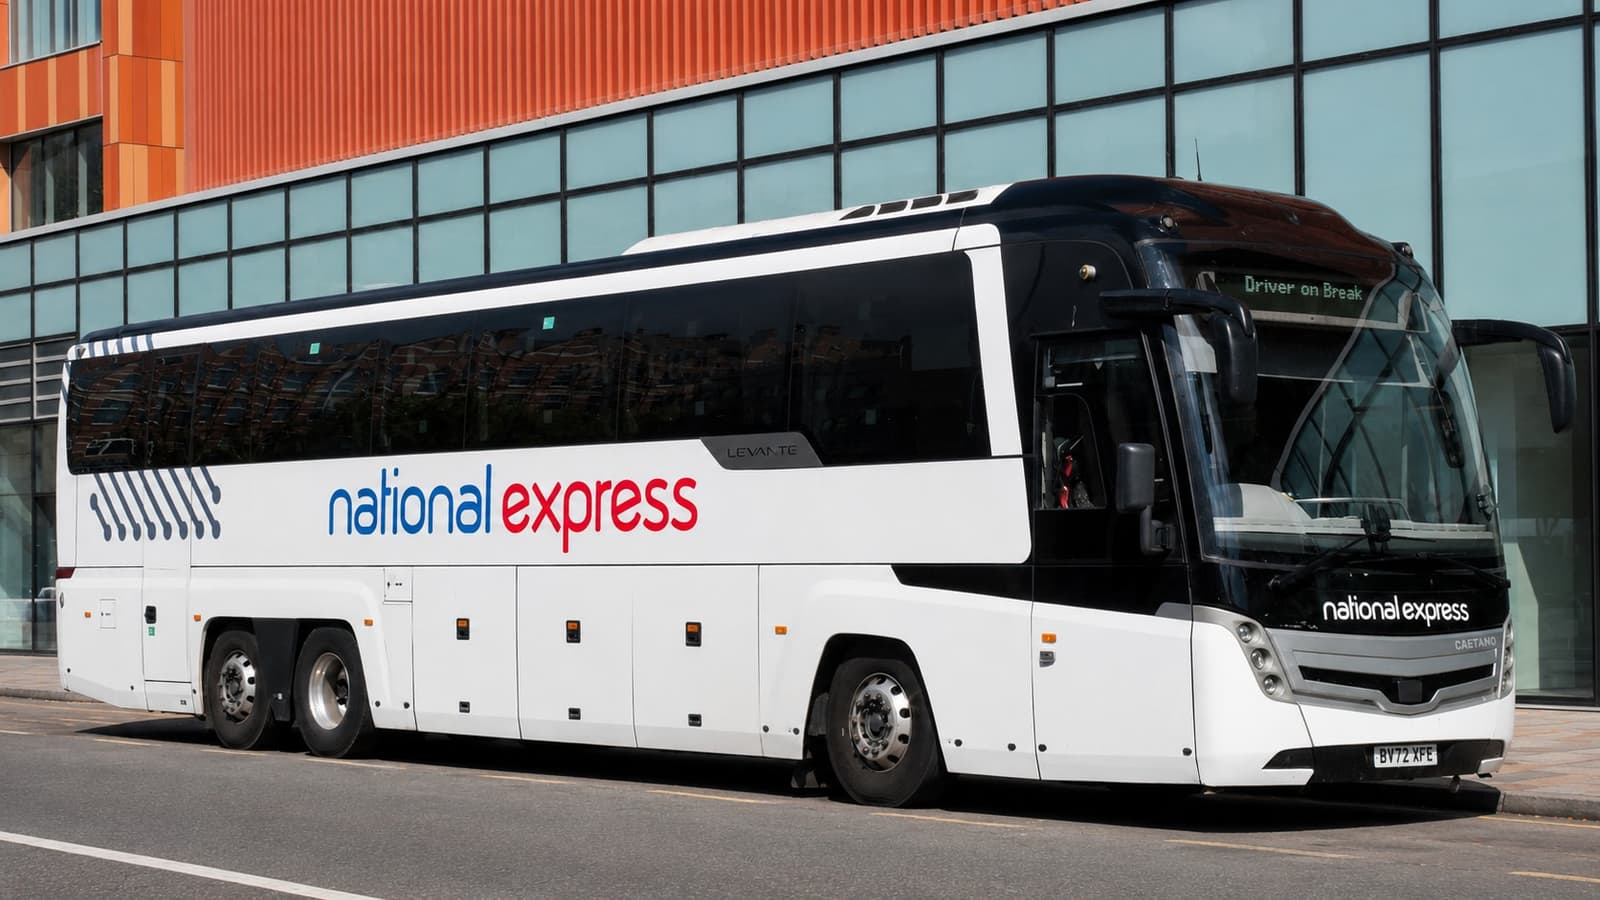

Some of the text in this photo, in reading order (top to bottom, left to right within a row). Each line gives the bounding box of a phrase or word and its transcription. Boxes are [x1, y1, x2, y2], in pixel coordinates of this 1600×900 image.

[1245, 275, 1362, 300] Driver on Break
[727, 445, 798, 458] LEVANTE
[328, 464, 698, 553] national express
[1322, 595, 1469, 627] national express
[1455, 636, 1497, 650] CAETANO
[1379, 746, 1433, 764] BV72 XFE
